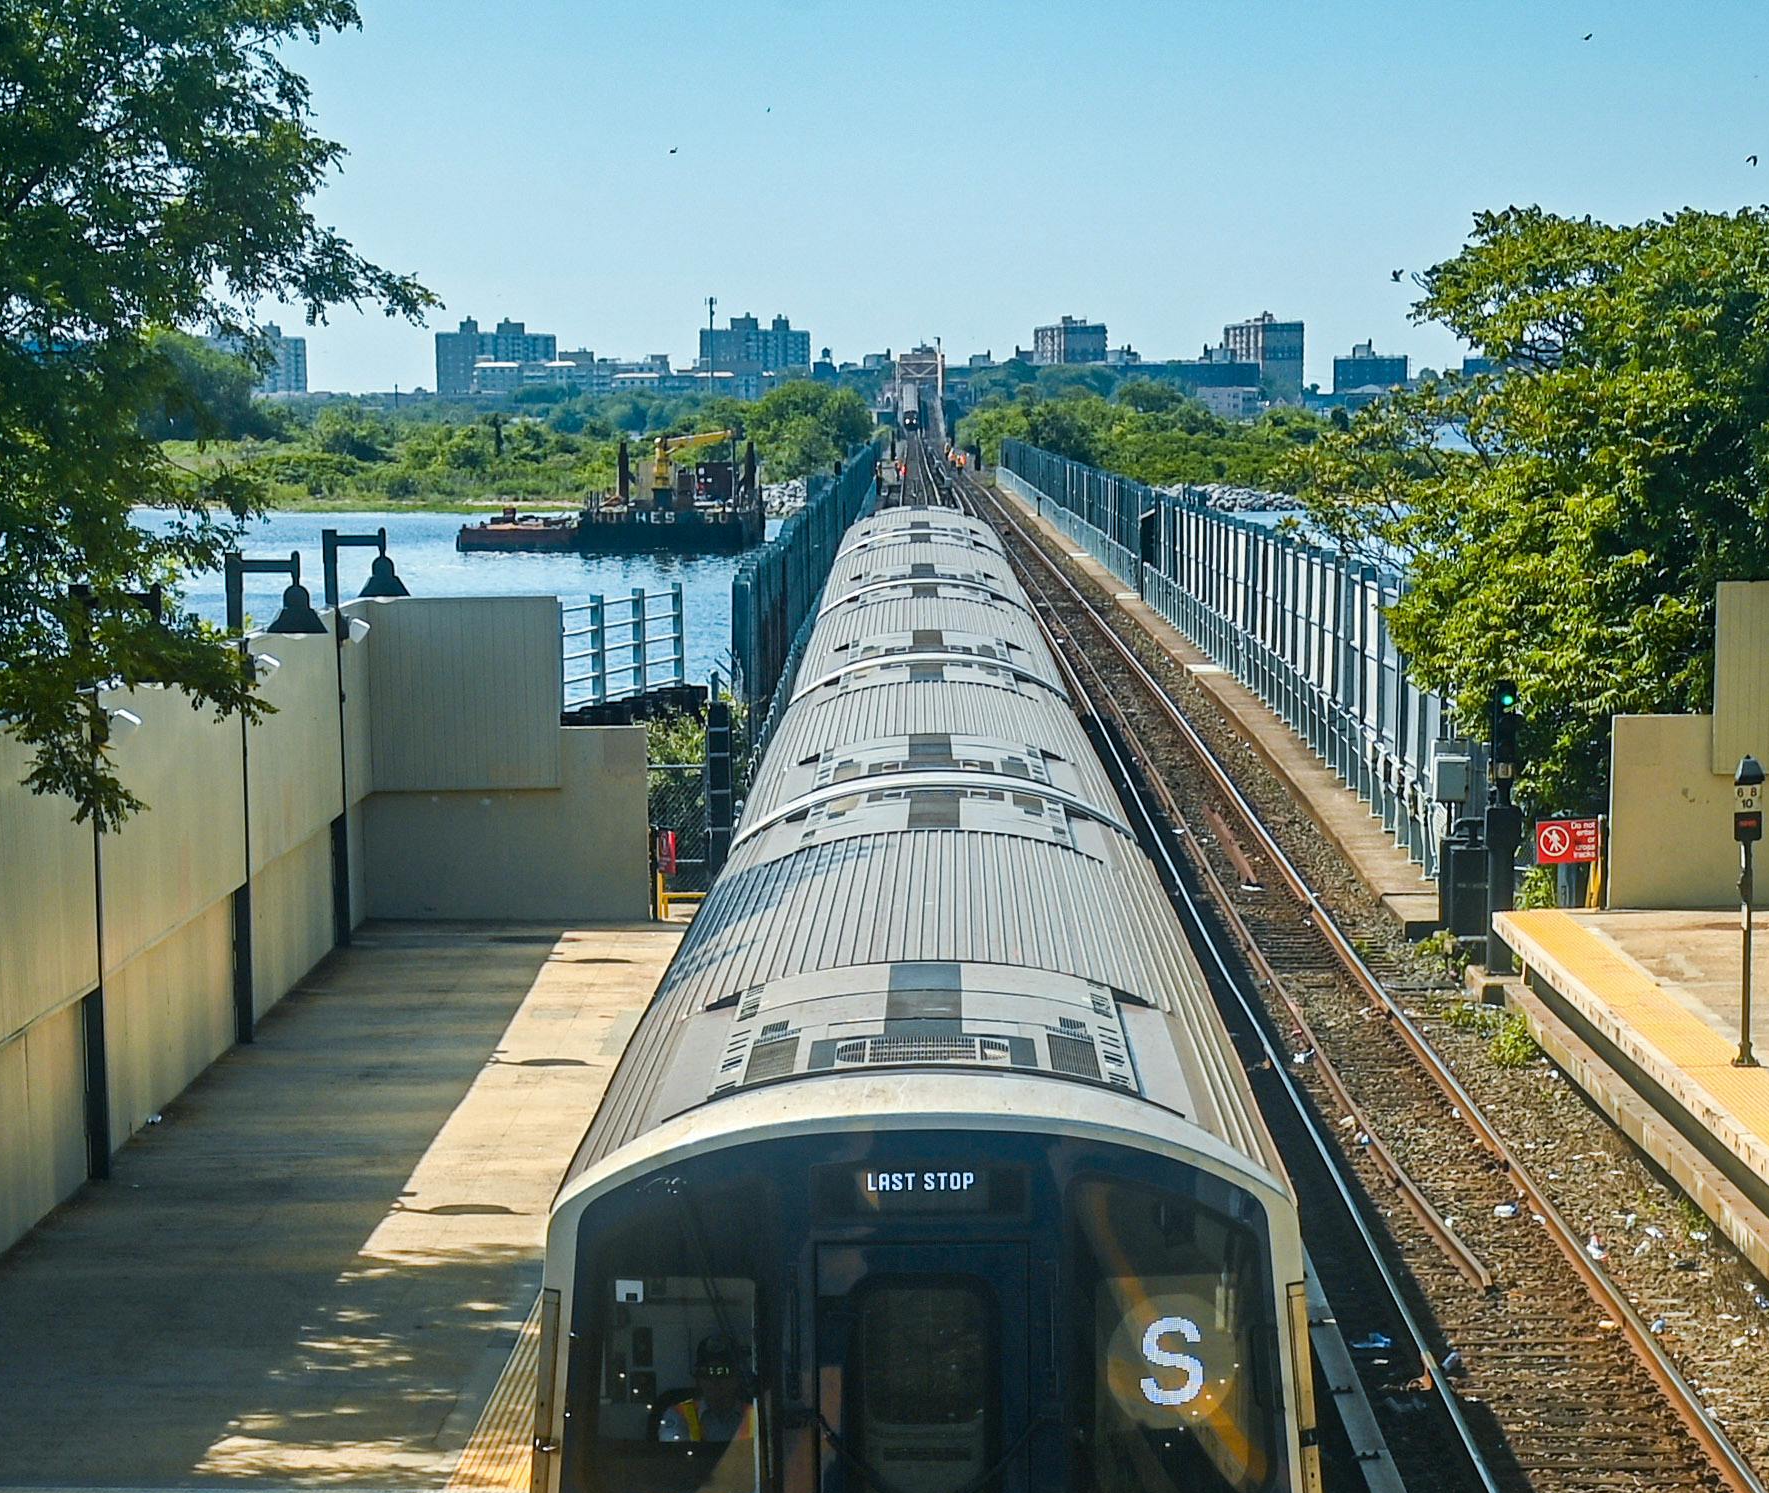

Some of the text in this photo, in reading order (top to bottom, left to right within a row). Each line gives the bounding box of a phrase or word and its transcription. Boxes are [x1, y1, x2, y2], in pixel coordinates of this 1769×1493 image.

[1751, 787, 1757, 797] 8
[1742, 799, 1753, 809] 10
[867, 1172, 974, 1191] LAST STOP
[1141, 1316, 1203, 1405] S
